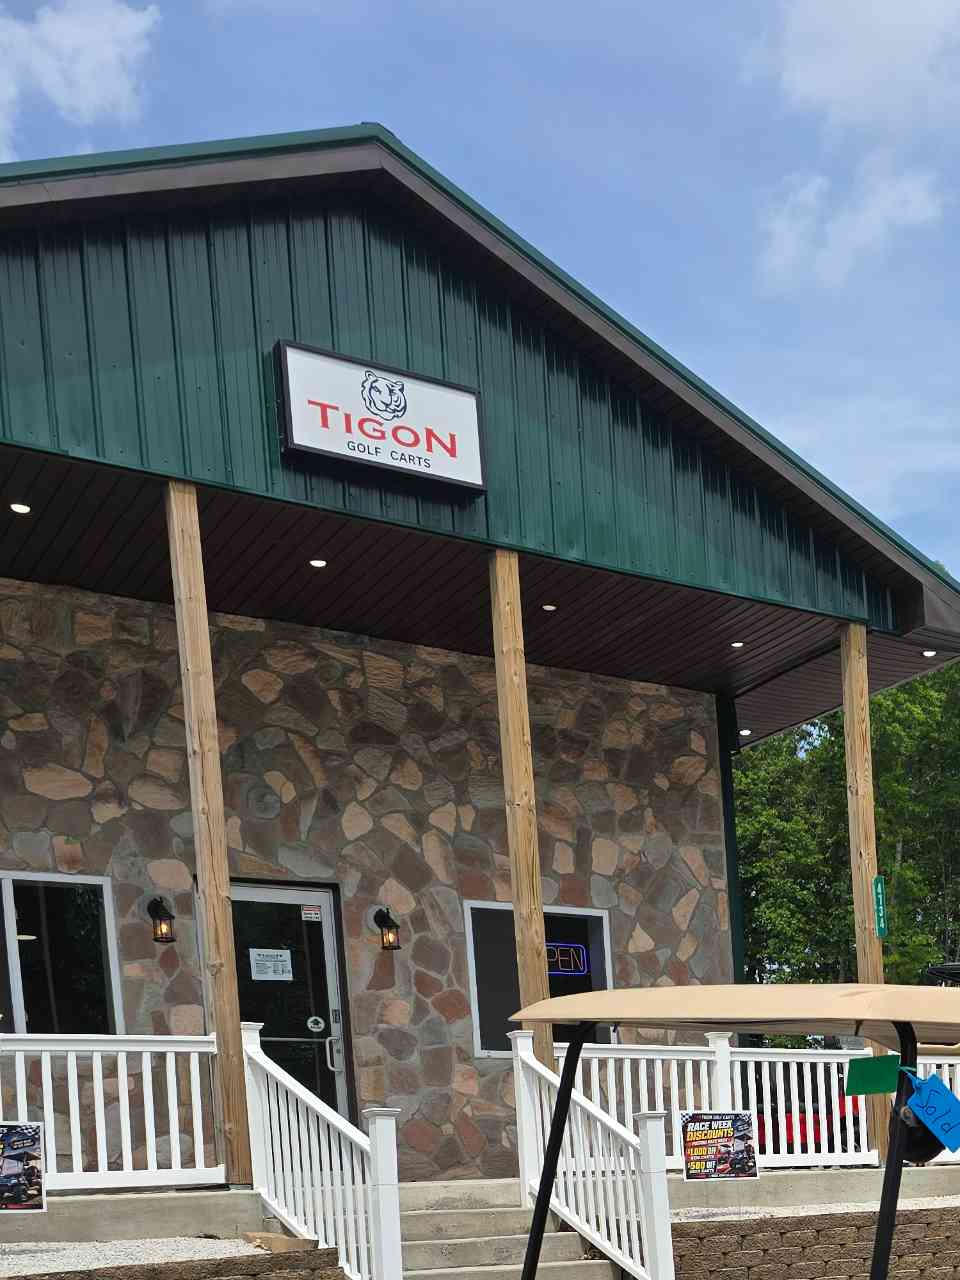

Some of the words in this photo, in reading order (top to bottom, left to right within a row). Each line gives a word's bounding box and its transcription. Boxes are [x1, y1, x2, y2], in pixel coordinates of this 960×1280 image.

[307, 399, 458, 458] TIGON
[347, 440, 382, 457] GOLF
[390, 450, 432, 469] CARTS
[546, 946, 584, 971] PEN
[687, 1128, 734, 1141] DISCOUNTS
[688, 1122, 711, 1131] RACE
[711, 1120, 733, 1129] WEEK
